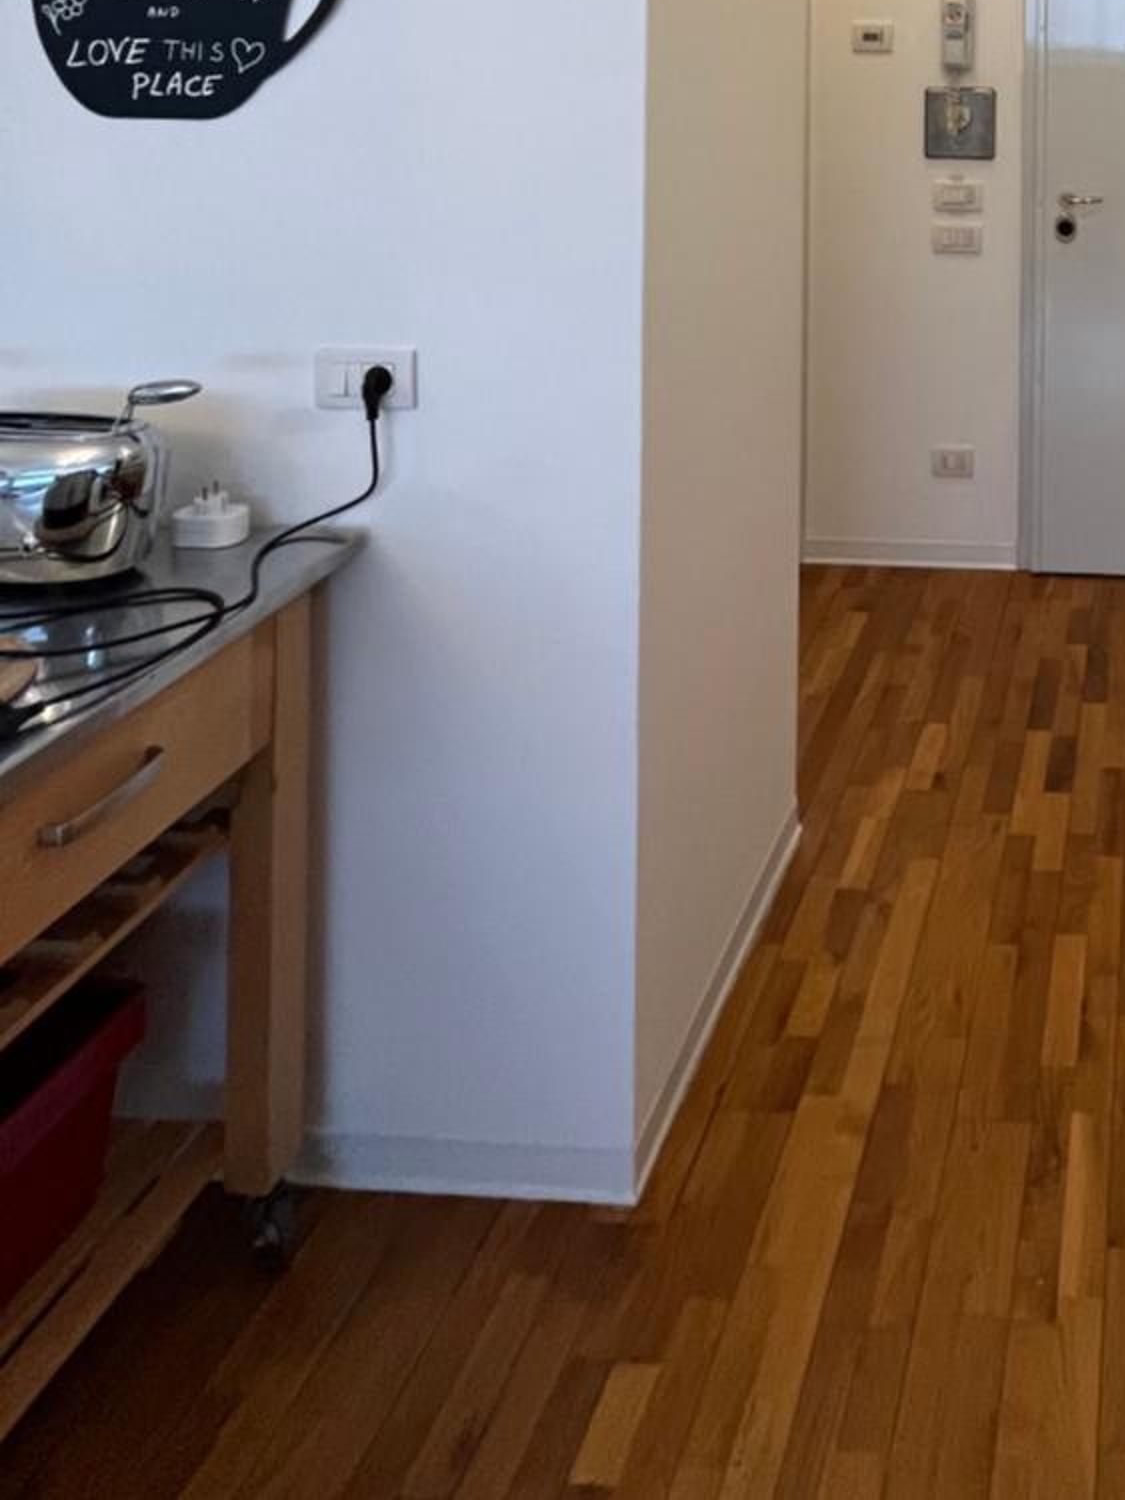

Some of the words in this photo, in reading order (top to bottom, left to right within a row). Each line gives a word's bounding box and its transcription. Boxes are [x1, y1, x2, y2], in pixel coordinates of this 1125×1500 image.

[147, 6, 180, 18] AND
[67, 37, 150, 67] LOVE
[164, 38, 224, 62] THIS
[132, 72, 223, 100] PLACE
